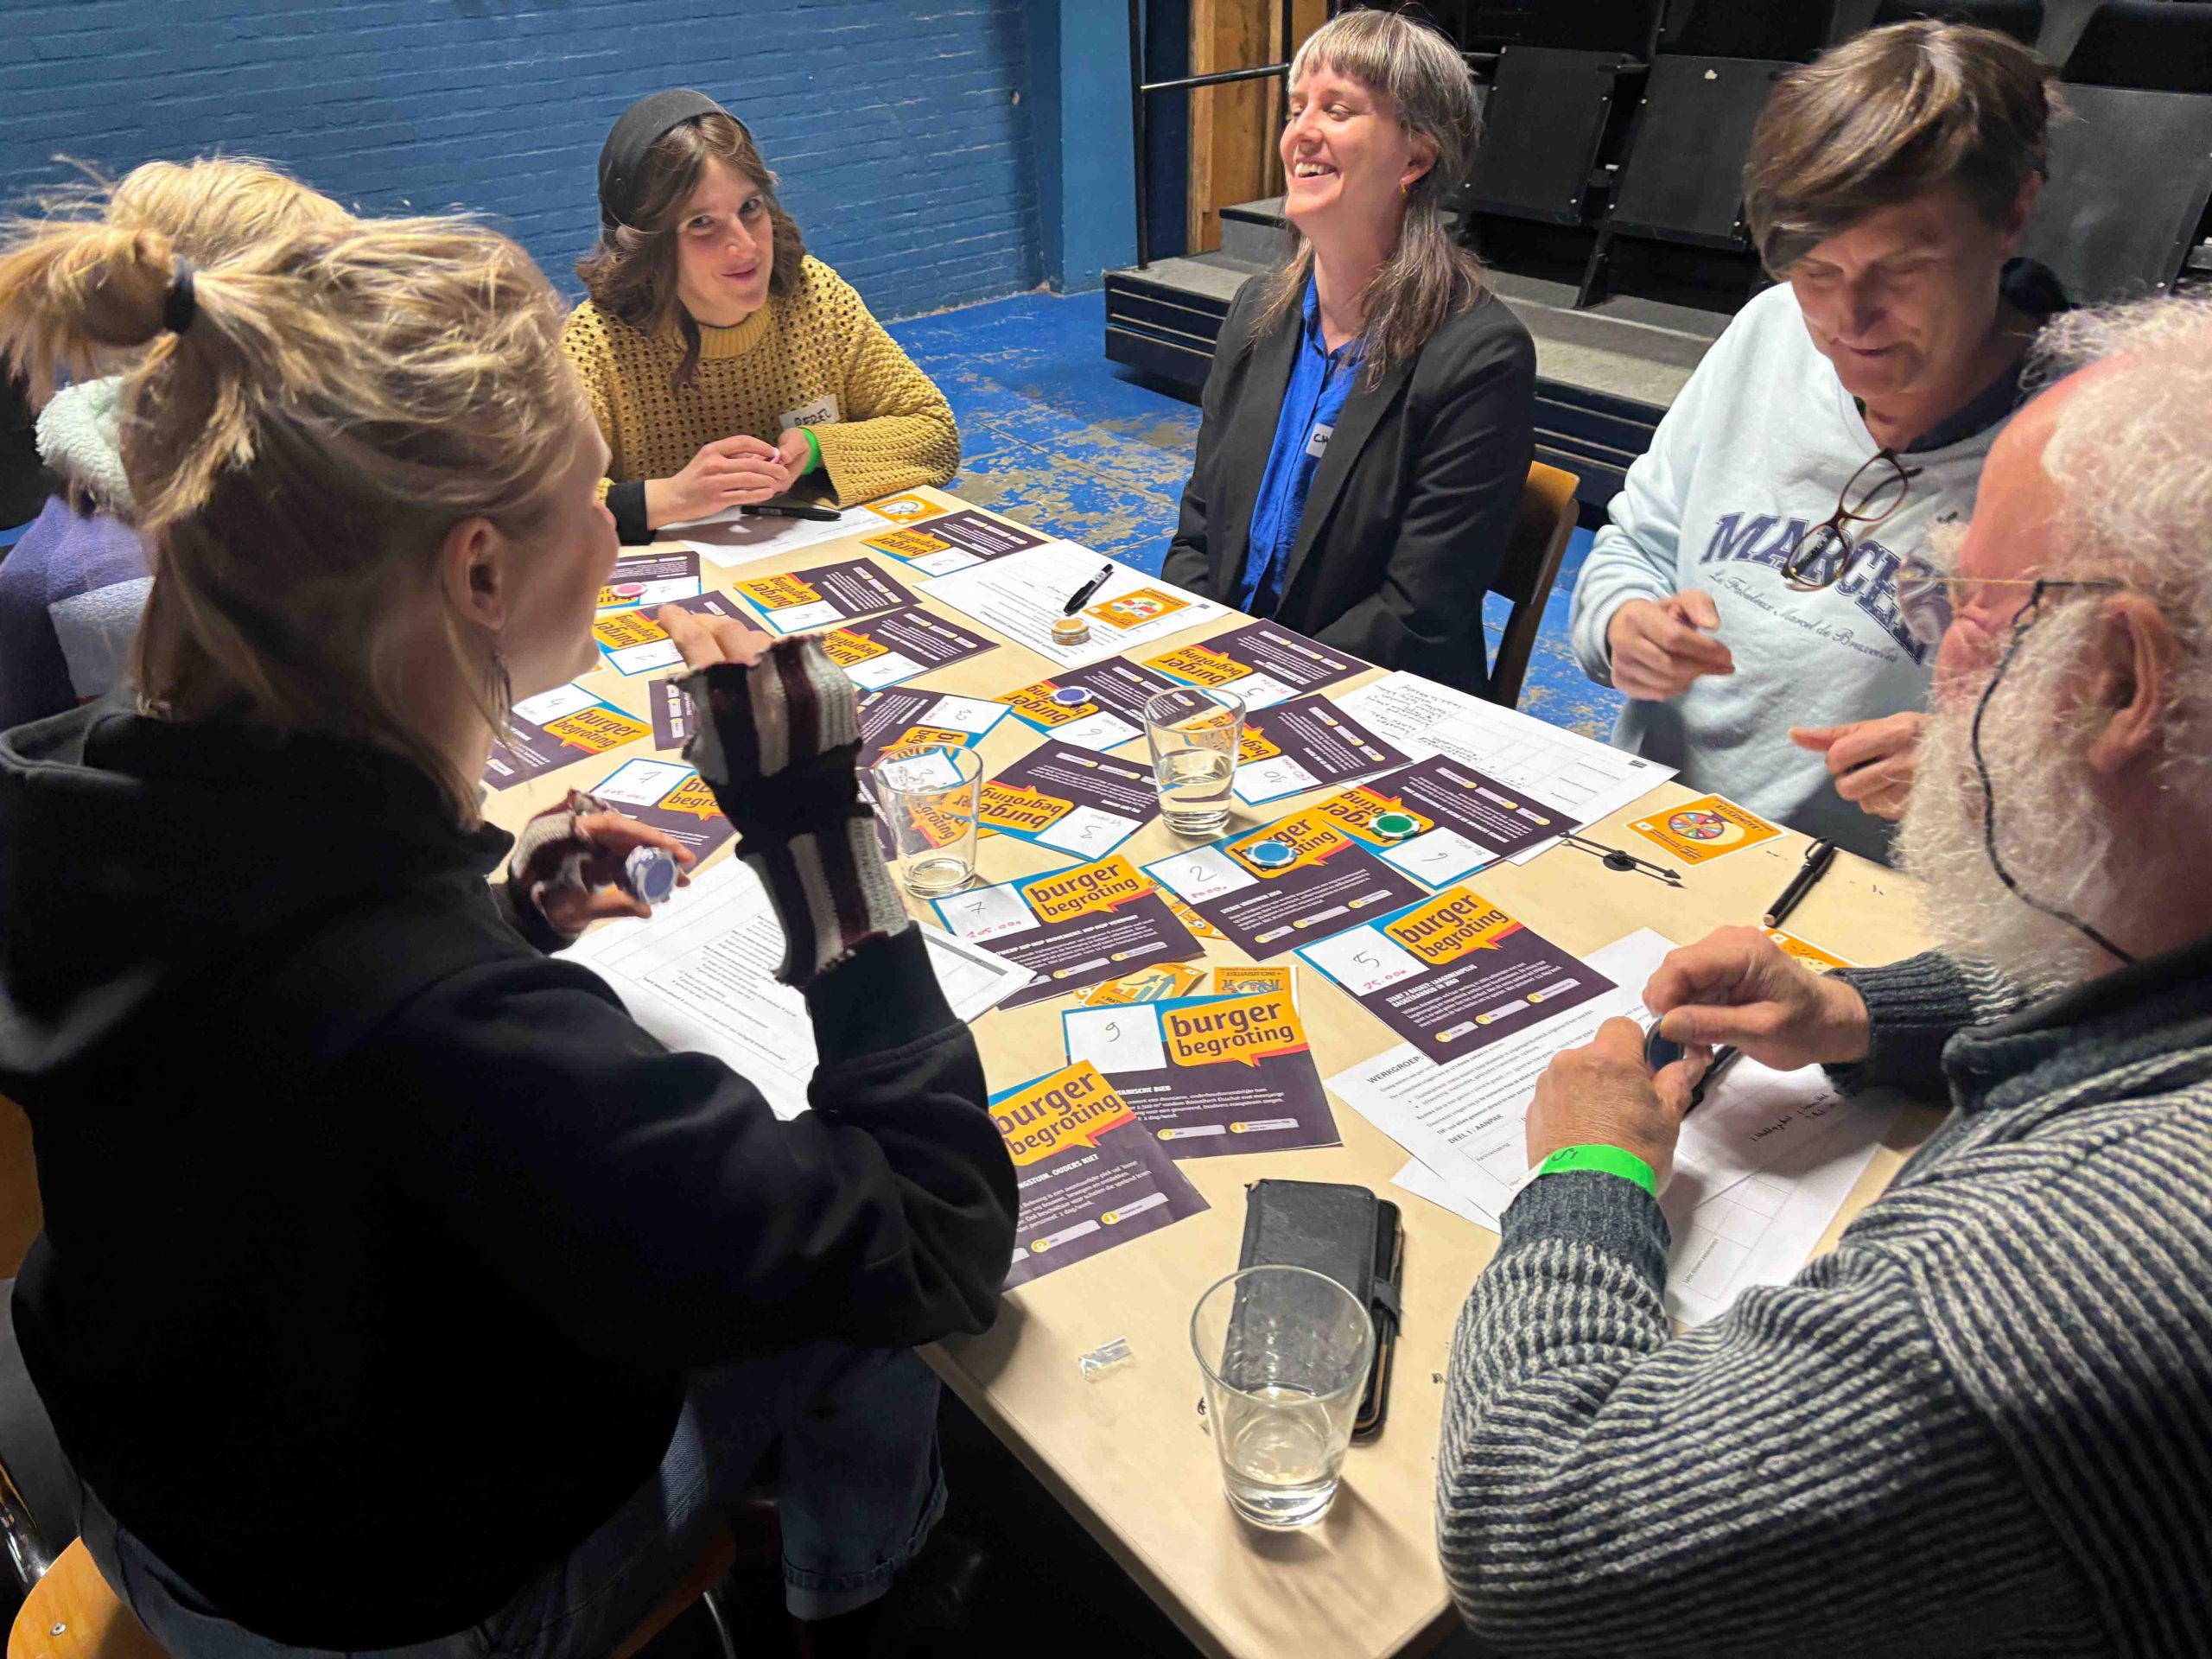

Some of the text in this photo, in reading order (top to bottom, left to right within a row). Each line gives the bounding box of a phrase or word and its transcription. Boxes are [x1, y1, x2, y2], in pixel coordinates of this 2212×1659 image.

[874, 537, 928, 557] burger
[747, 582, 797, 609] burger
[1773, 607, 1816, 636] Marcel
[1815, 621, 1832, 639] de
[1157, 657, 1228, 685] burger
[1177, 647, 1244, 678] begroting
[574, 708, 643, 738] burger
[1003, 694, 1071, 725] burger
[553, 719, 618, 748] begroting
[1028, 861, 1122, 904] burger
[1188, 864, 1217, 882] 2
[964, 899, 988, 915] 7
[1040, 876, 1141, 917] begroting
[1390, 893, 1482, 945] burger
[1415, 907, 1510, 958] begroting
[1351, 950, 1381, 969] 5
[1104, 1021, 1121, 1043] 9
[1170, 1001, 1282, 1039] burger
[1177, 1024, 1296, 1058] begroting
[1365, 1052, 1425, 1085] WERKGROEP:
[990, 1071, 1096, 1136] burger
[1005, 1093, 1123, 1157] begroting
[1446, 1131, 1468, 1144] DEEL
[1473, 1113, 1505, 1131] AANPAK
[1051, 1159, 1083, 1177] OUDERS
[1081, 1152, 1099, 1165] NIET
